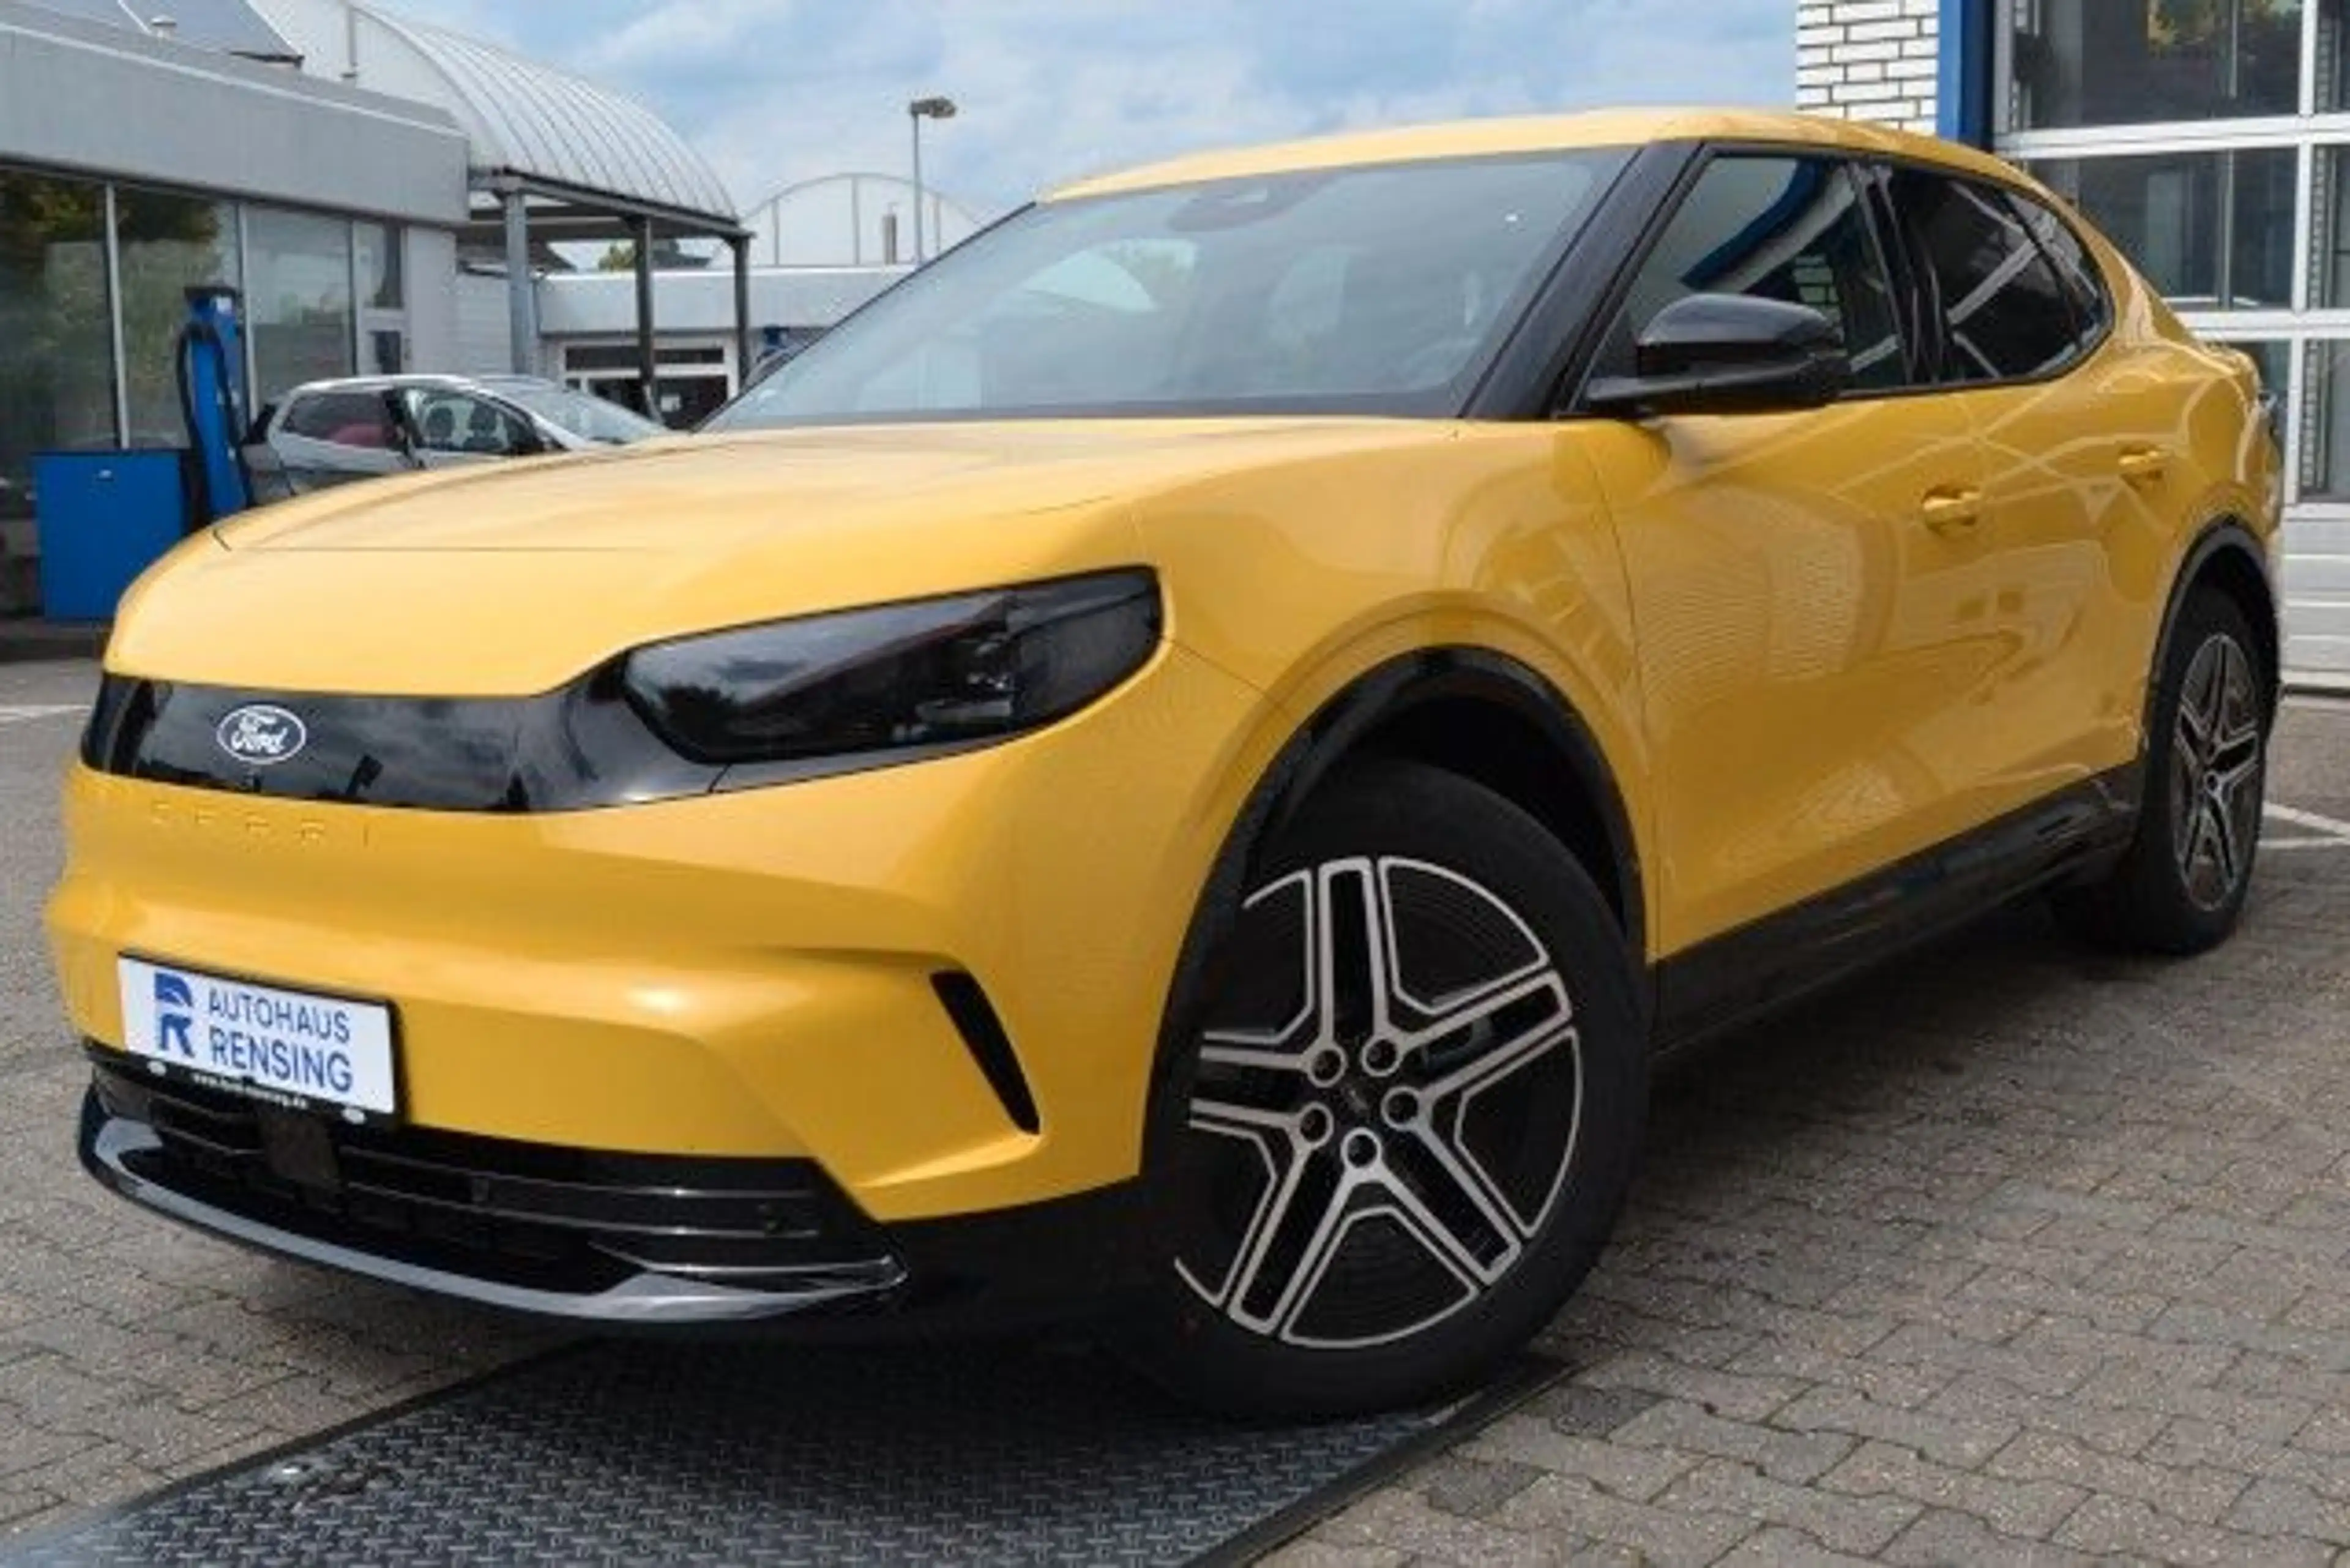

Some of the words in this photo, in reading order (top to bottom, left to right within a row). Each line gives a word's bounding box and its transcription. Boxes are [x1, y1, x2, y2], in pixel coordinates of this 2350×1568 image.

[231, 712, 288, 754] Ford
[208, 988, 350, 1043] AUTOHAUS
[209, 1026, 353, 1092] RENSING
